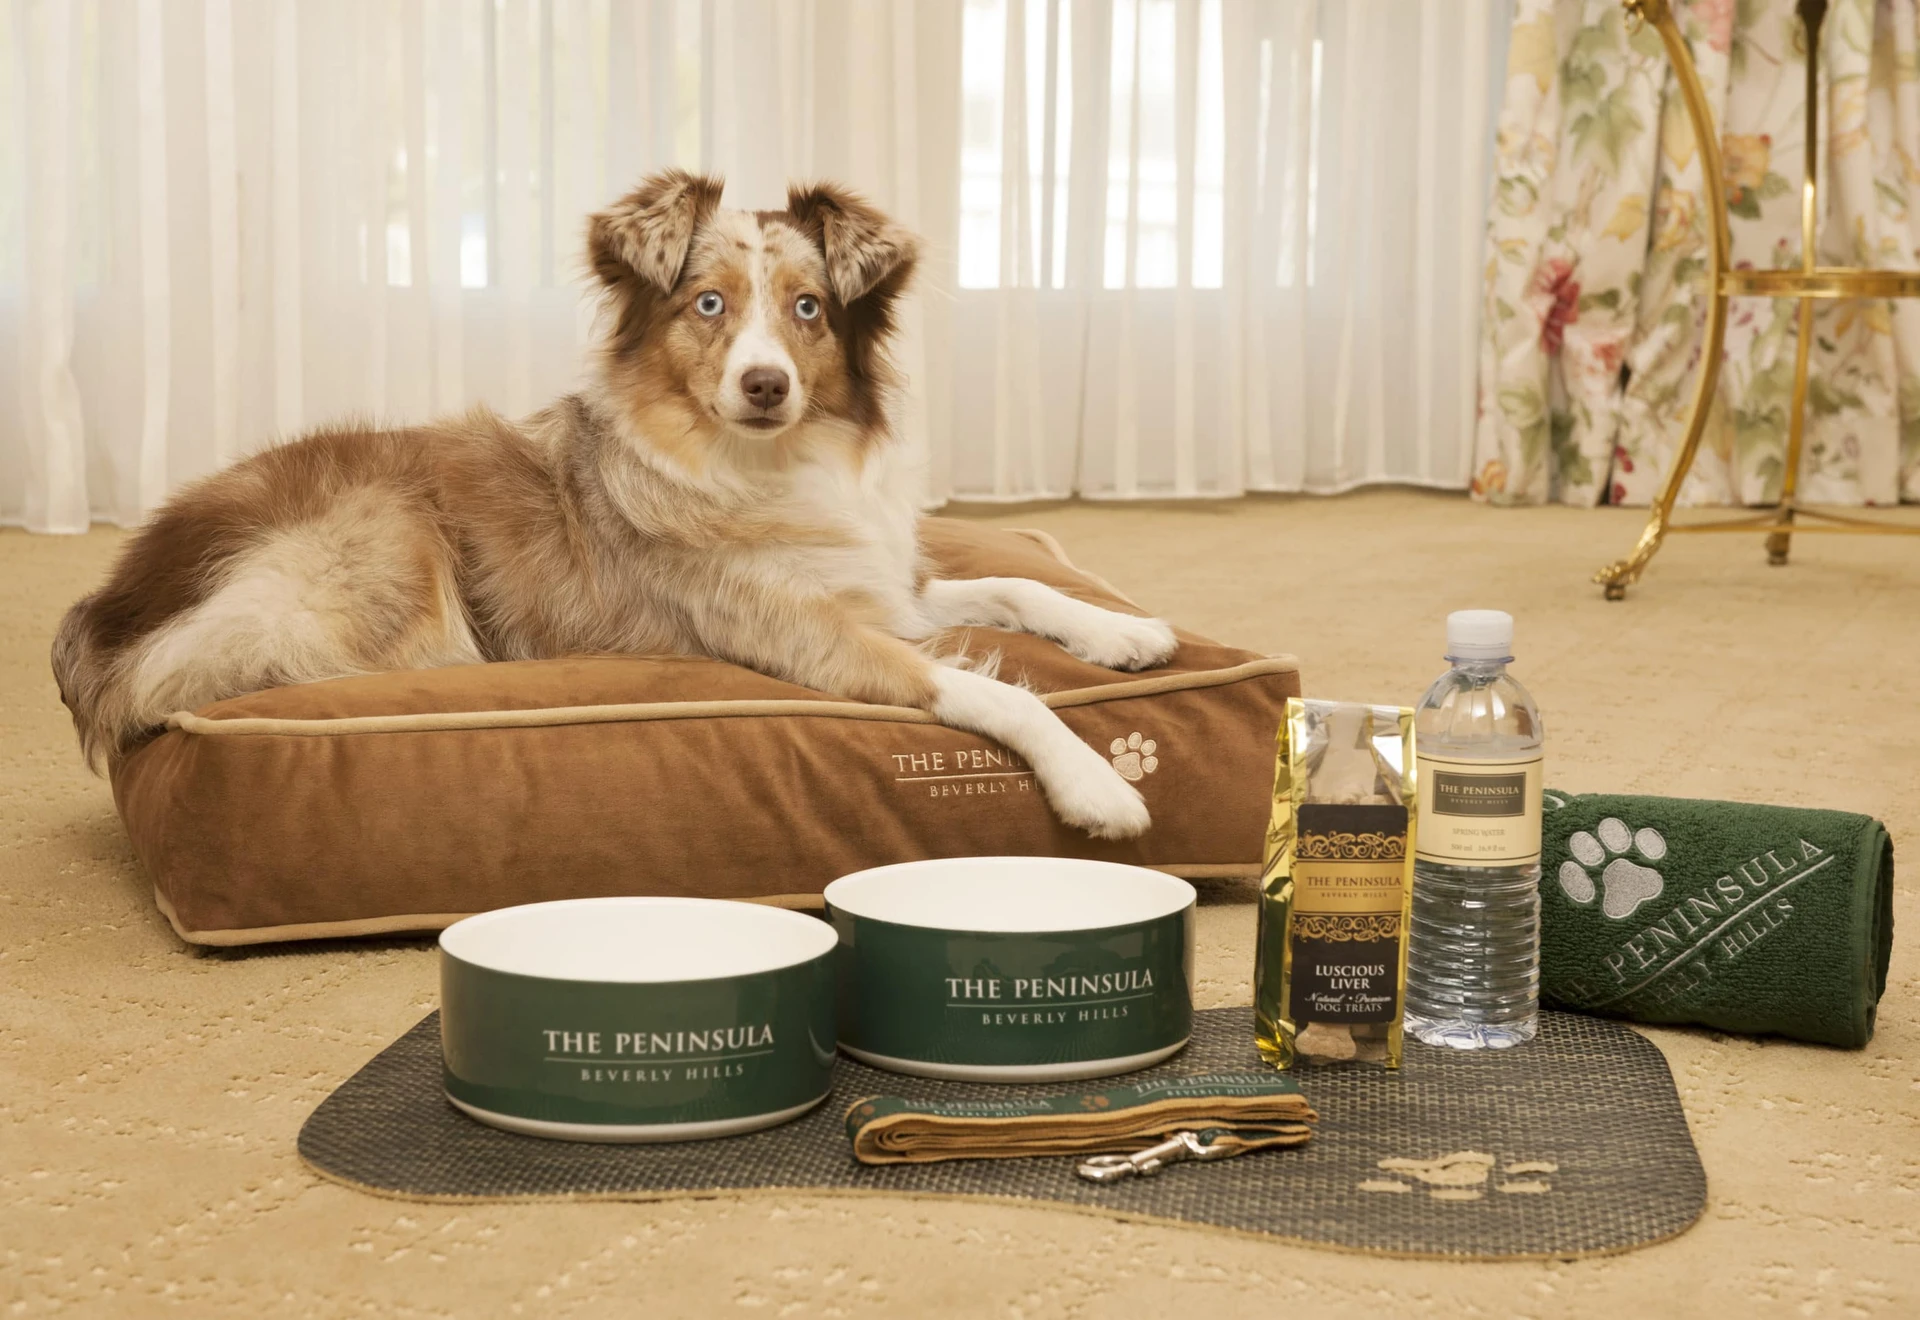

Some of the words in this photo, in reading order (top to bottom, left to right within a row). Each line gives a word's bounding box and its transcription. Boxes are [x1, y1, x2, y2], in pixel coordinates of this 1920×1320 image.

[892, 751, 945, 773] THE
[930, 781, 1007, 797] BEVERLY
[1440, 784, 1459, 794] THE
[1463, 785, 1519, 795] PENINSULA
[1306, 876, 1331, 886] THE
[1335, 876, 1401, 886] PENINSULA
[1602, 838, 1824, 985] PENINSULA
[1720, 897, 1794, 959] HILLS
[1315, 964, 1385, 976] LUSCIOUS
[945, 977, 1001, 999] THE
[1014, 968, 1154, 999] PENINSULA
[1330, 978, 1371, 990] LIVER
[982, 1011, 1067, 1025] BEVERLY
[1078, 1005, 1129, 1022] HILLS
[1315, 1002, 1341, 1012] DOG
[1344, 1002, 1382, 1013] TREATS
[543, 1030, 601, 1054] THE
[615, 1023, 774, 1054] PENINSULA
[581, 1069, 673, 1082] BEVERLY
[686, 1063, 744, 1080] HILLS
[1132, 1078, 1171, 1094] THE
[1177, 1074, 1283, 1087] PENINSULA
[1167, 1087, 1220, 1096] BEVERLY
